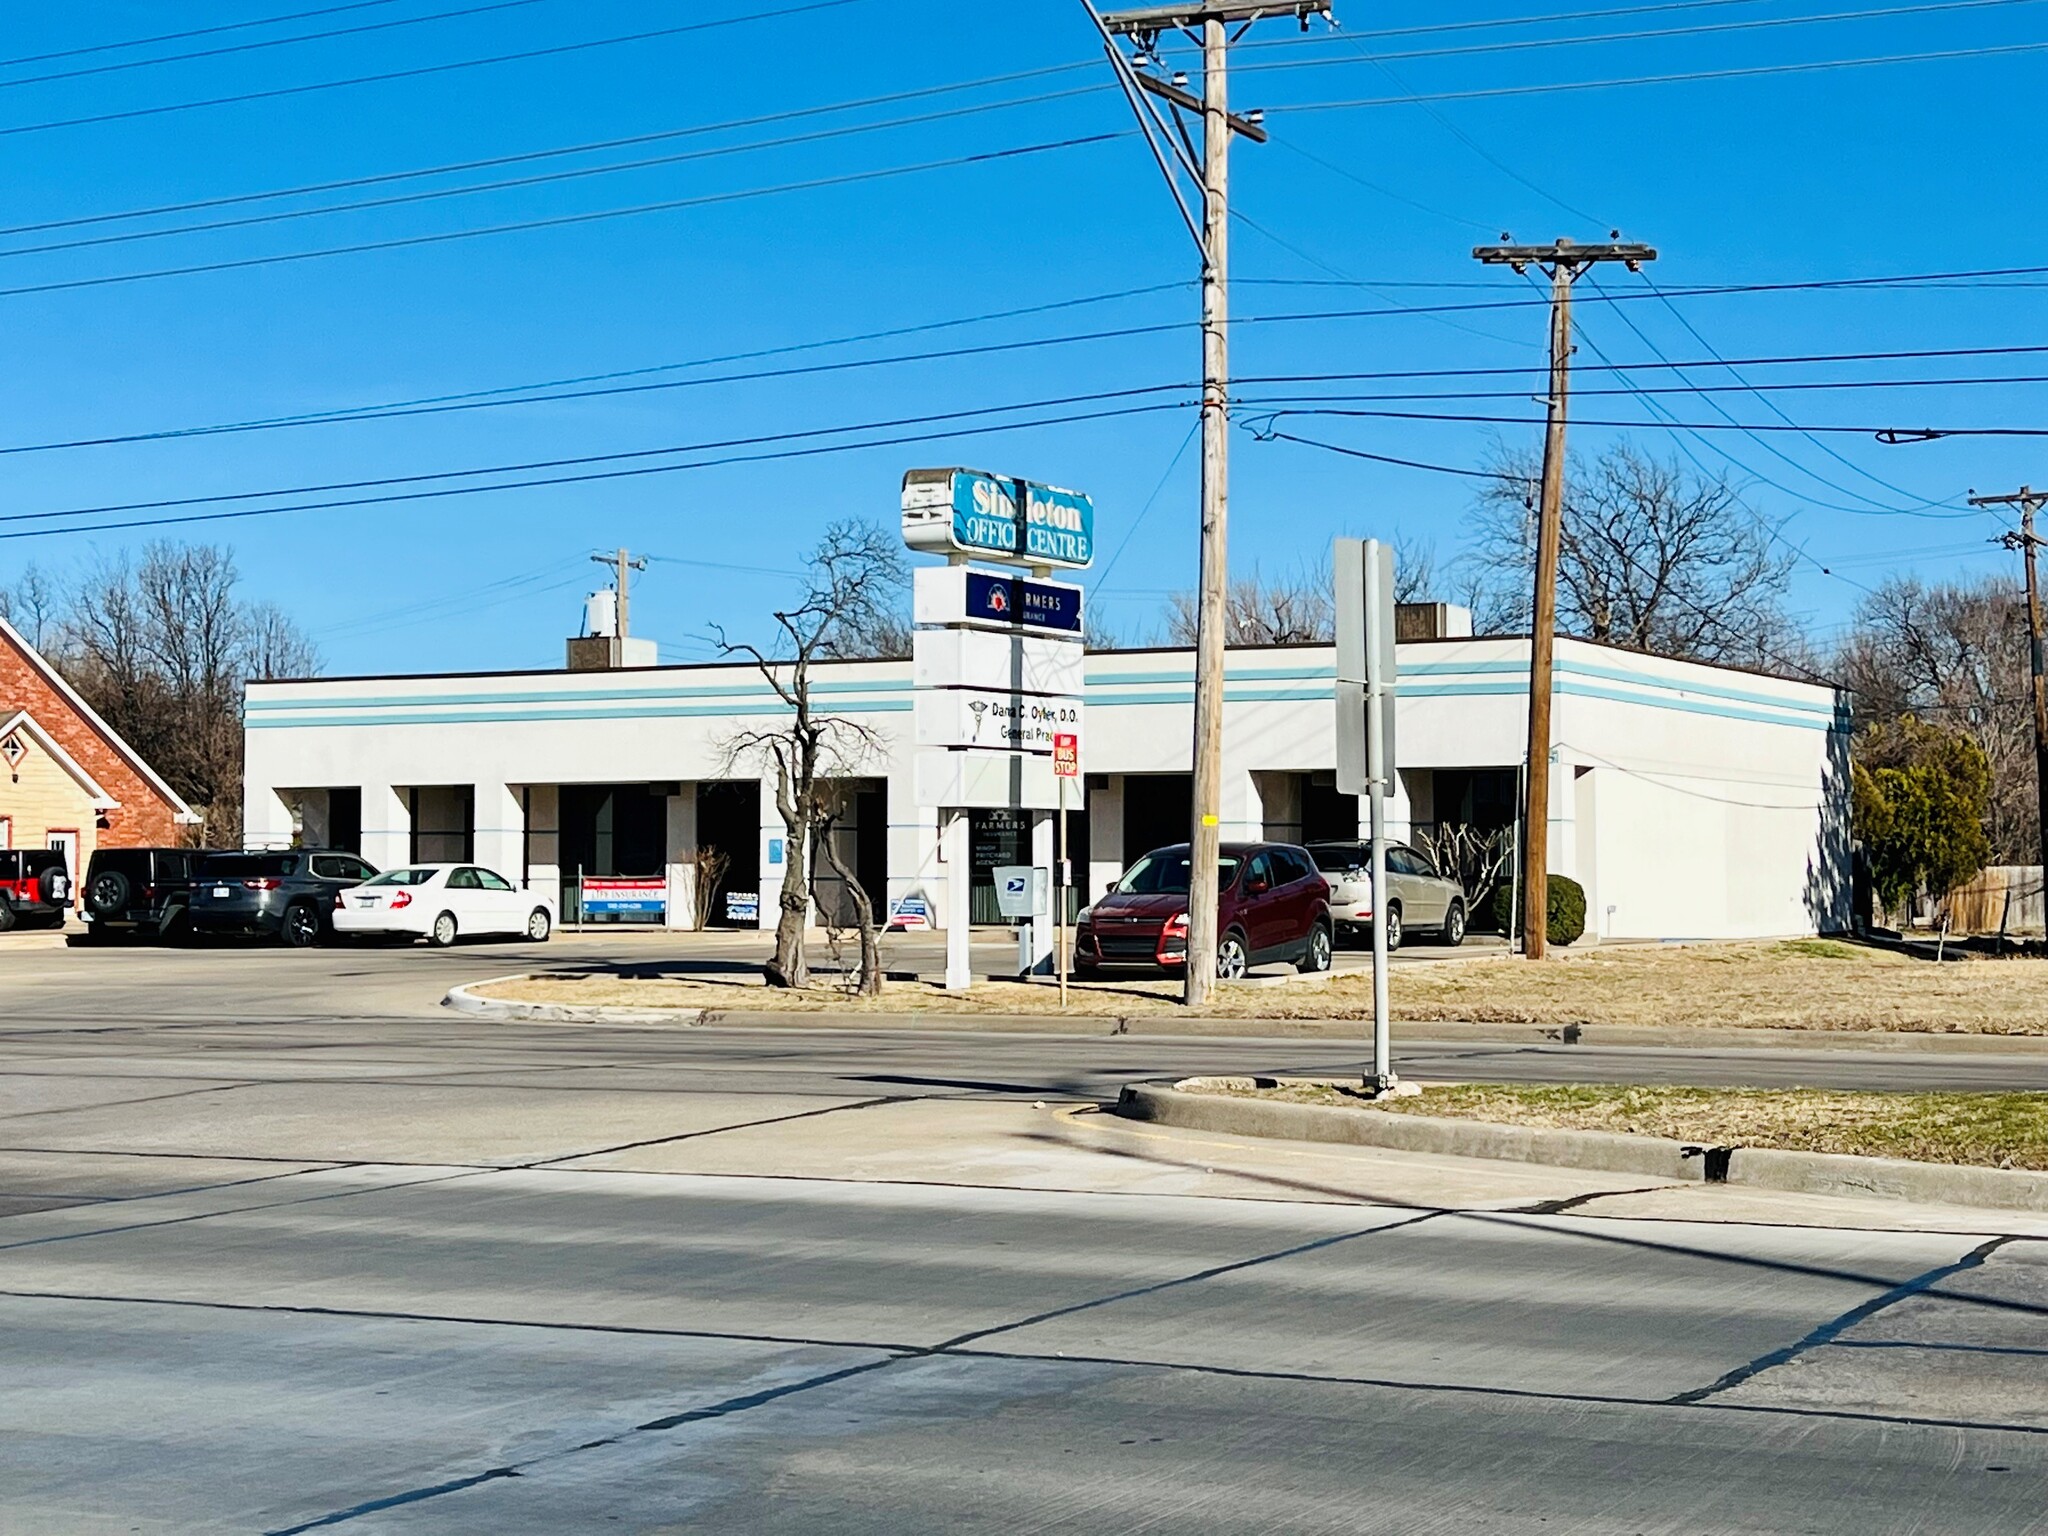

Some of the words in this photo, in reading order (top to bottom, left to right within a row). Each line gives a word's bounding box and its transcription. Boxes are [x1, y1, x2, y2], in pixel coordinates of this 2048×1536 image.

[972, 480, 1083, 532] Singleton
[1027, 527, 1088, 560] CENTRE
[992, 702, 1017, 718] Dana
[1060, 708, 1079, 722] D.O.
[1001, 725, 1034, 740] General
[1057, 747, 1075, 761] BUS
[1055, 760, 1077, 774] STOP
[975, 821, 1026, 830] FARMERS
